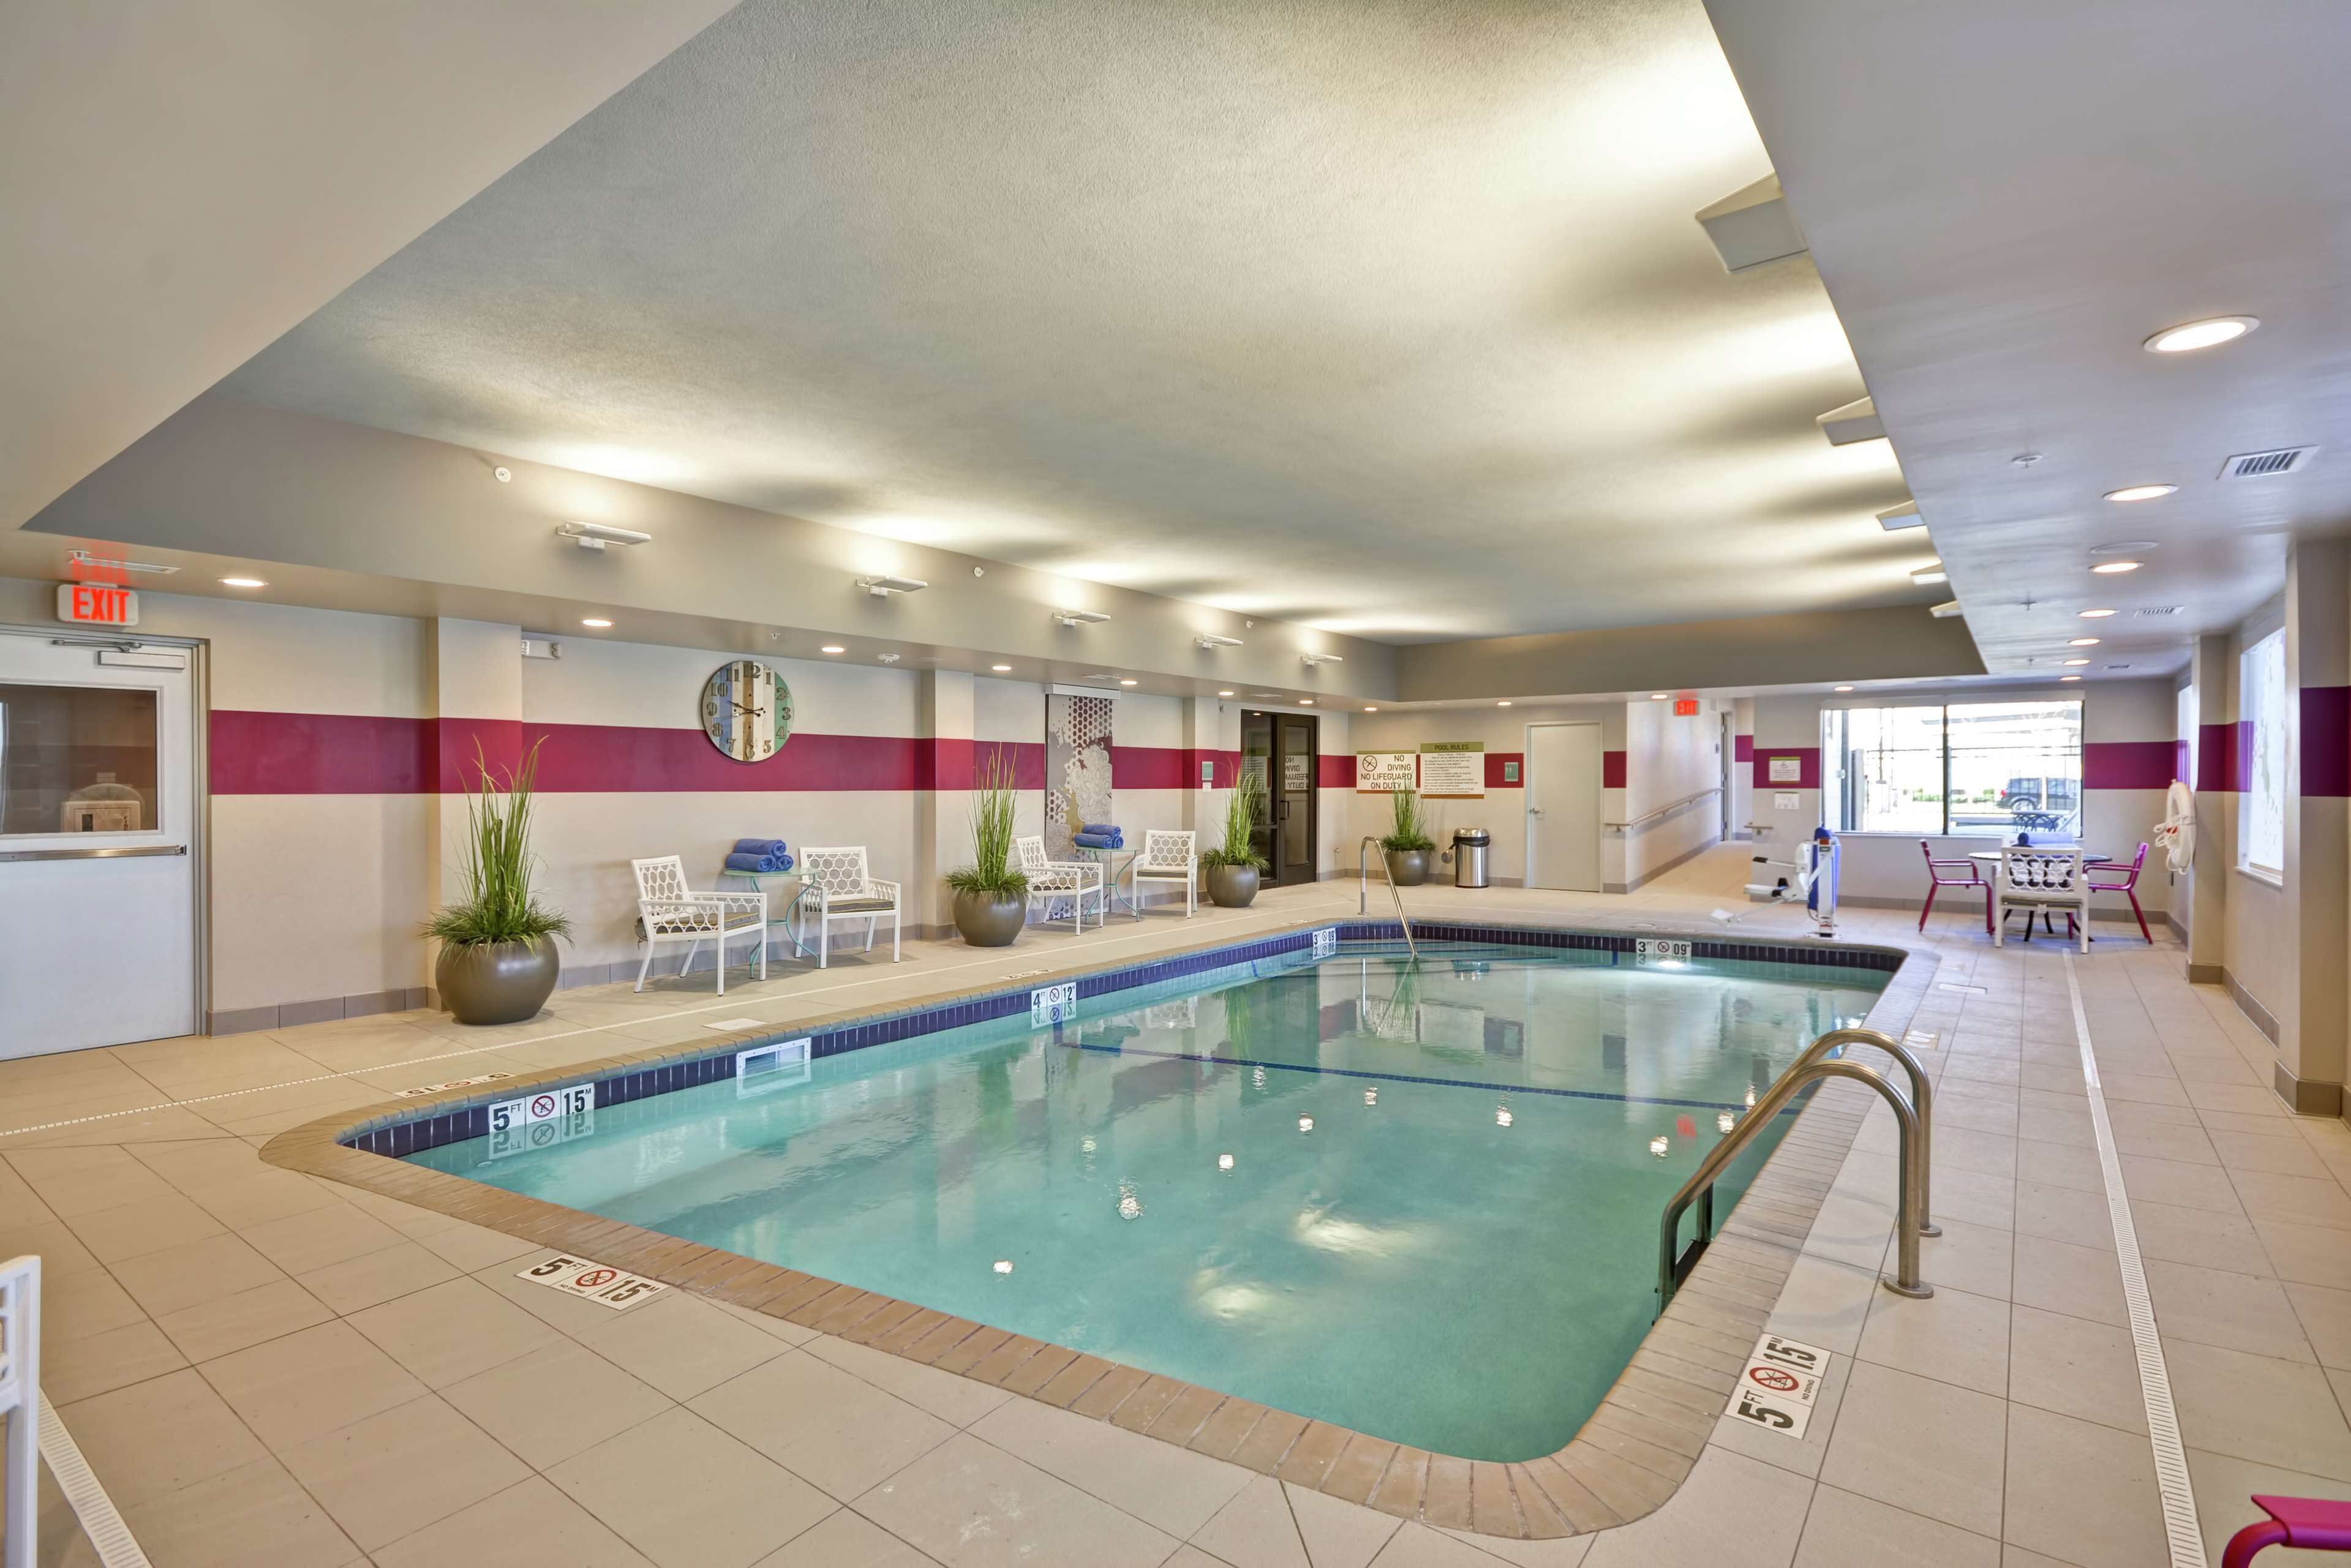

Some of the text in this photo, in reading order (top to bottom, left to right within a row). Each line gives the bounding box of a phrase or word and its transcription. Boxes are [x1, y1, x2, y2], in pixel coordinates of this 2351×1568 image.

[72, 586, 130, 623] EXIT
[726, 668, 740, 682] 11
[743, 664, 761, 678] 12
[765, 672, 772, 685] 1
[710, 683, 728, 697] 10
[776, 687, 787, 700] 2
[707, 702, 718, 716] 9
[782, 707, 791, 721] 3
[712, 722, 723, 737] 8
[776, 726, 786, 740] 4
[726, 738, 736, 752] 7
[745, 744, 755, 759] 6
[763, 740, 772, 753] 5
[1314, 934, 1318, 945] 3
[1638, 941, 1646, 953] 3
[1033, 992, 1040, 1008] 4
[492, 1106, 510, 1131] 5
[511, 1103, 522, 1113] FT
[563, 1089, 585, 1115] 1.5
[530, 1257, 574, 1277] 5
[566, 1261, 588, 1271] FT
[598, 1279, 652, 1302] 1.5
[1737, 1336, 1817, 1429] 5 FT 1.5 M
[1802, 1379, 1815, 1401] NO DIVING
